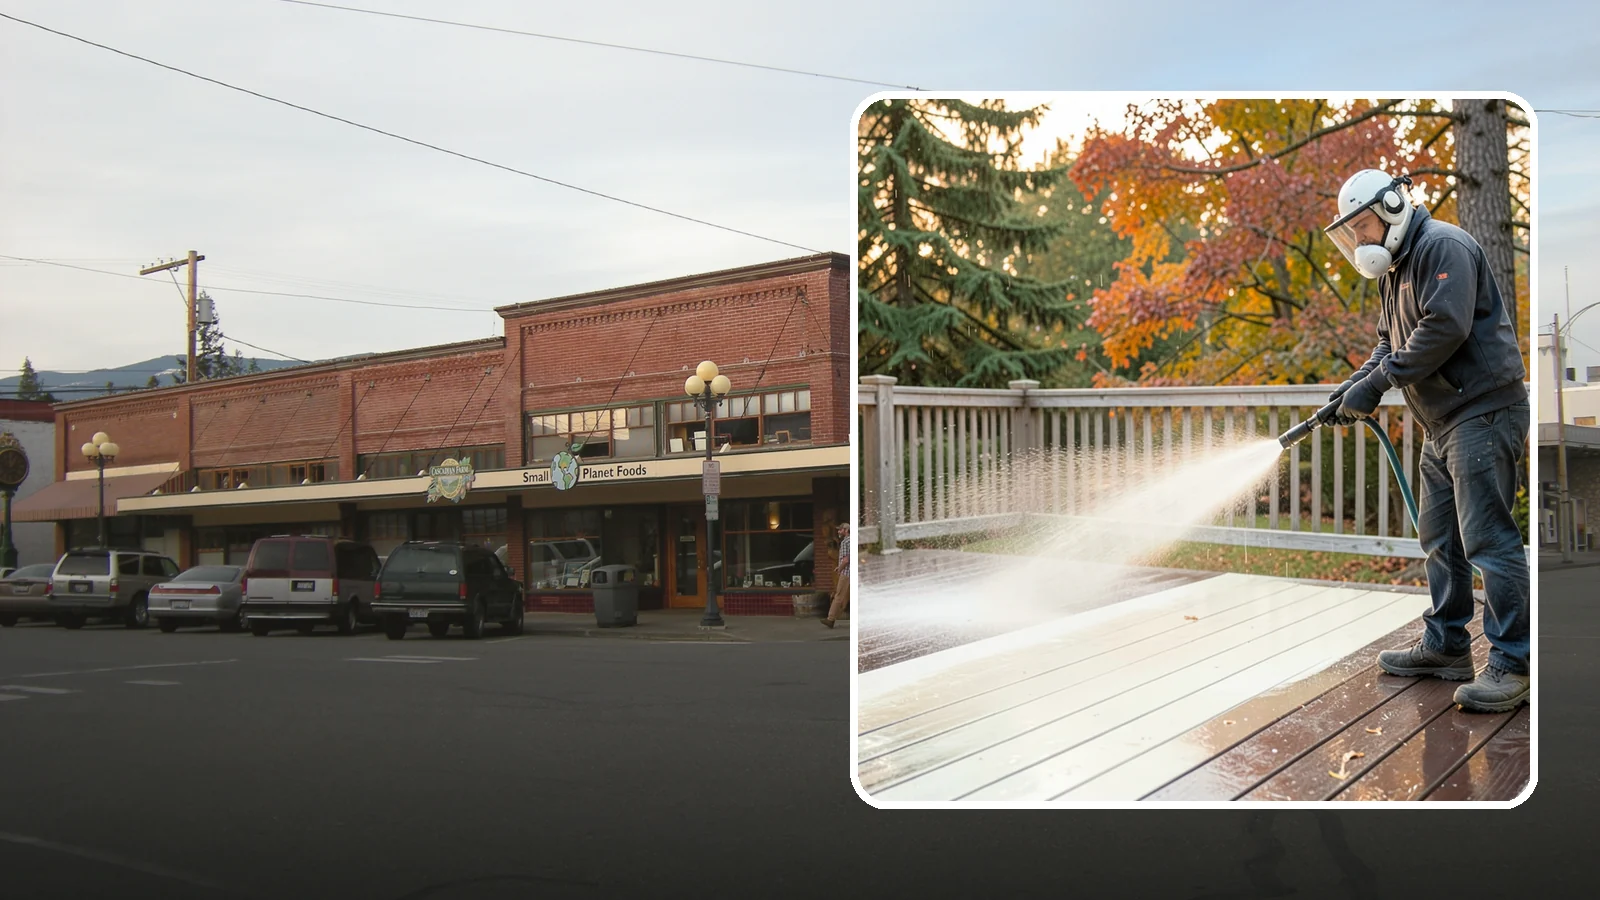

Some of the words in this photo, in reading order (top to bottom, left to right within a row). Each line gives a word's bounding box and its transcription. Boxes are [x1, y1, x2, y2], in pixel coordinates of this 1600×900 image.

[523, 471, 548, 482] Small
[583, 468, 614, 479] Planet
[617, 464, 646, 476] Foods
